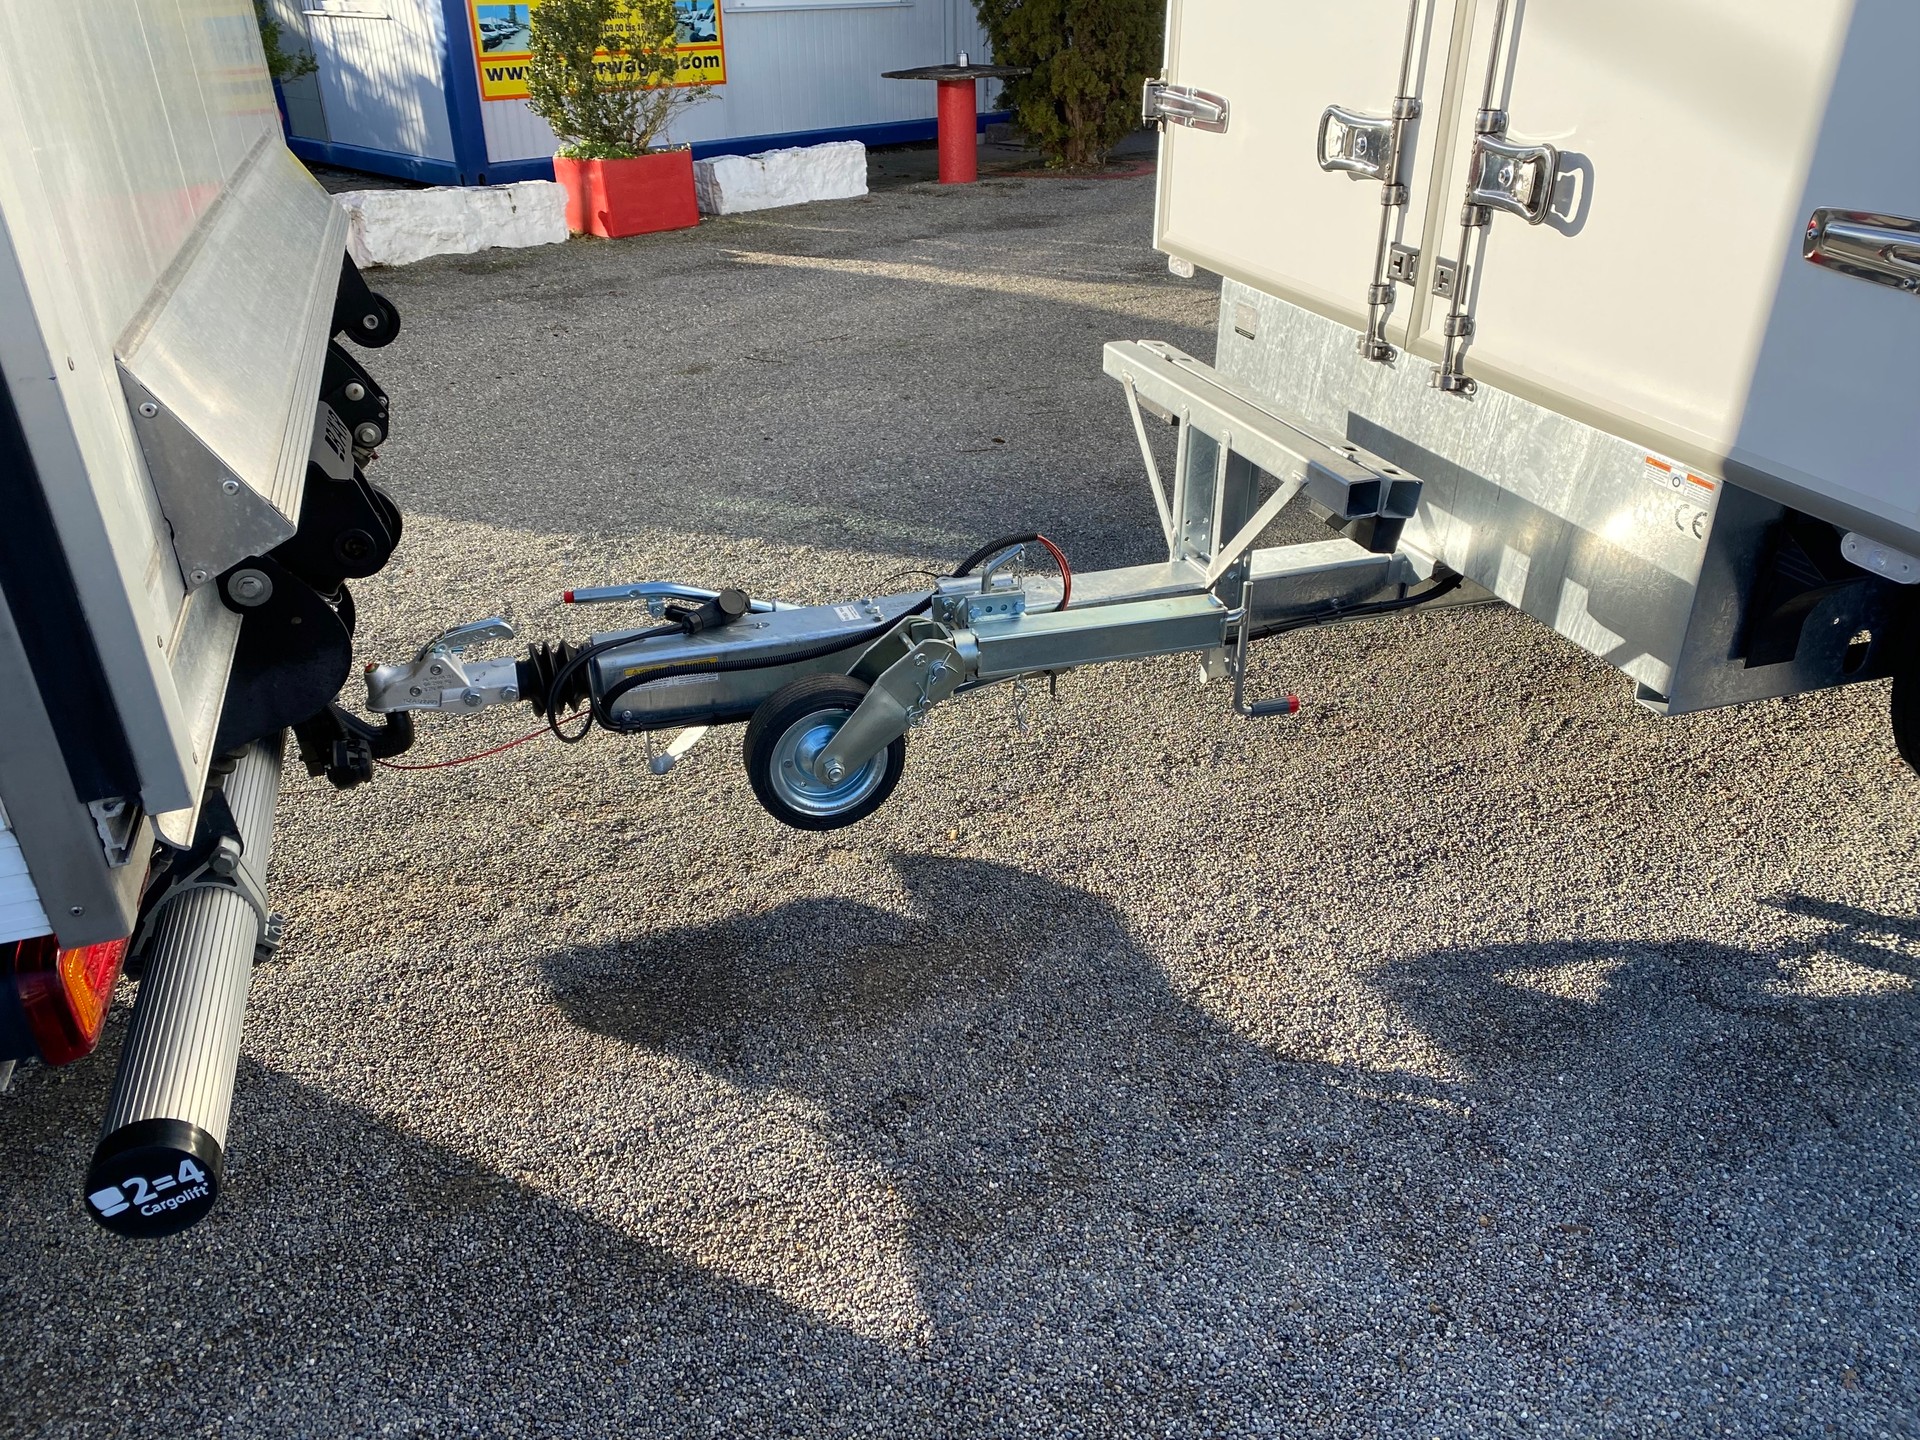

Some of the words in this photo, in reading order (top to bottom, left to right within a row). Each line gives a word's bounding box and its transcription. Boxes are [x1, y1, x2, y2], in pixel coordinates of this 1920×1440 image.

[1674, 503, 1709, 540] CE
[121, 1158, 206, 1206] 2=4
[140, 1185, 209, 1216] Cargolift
